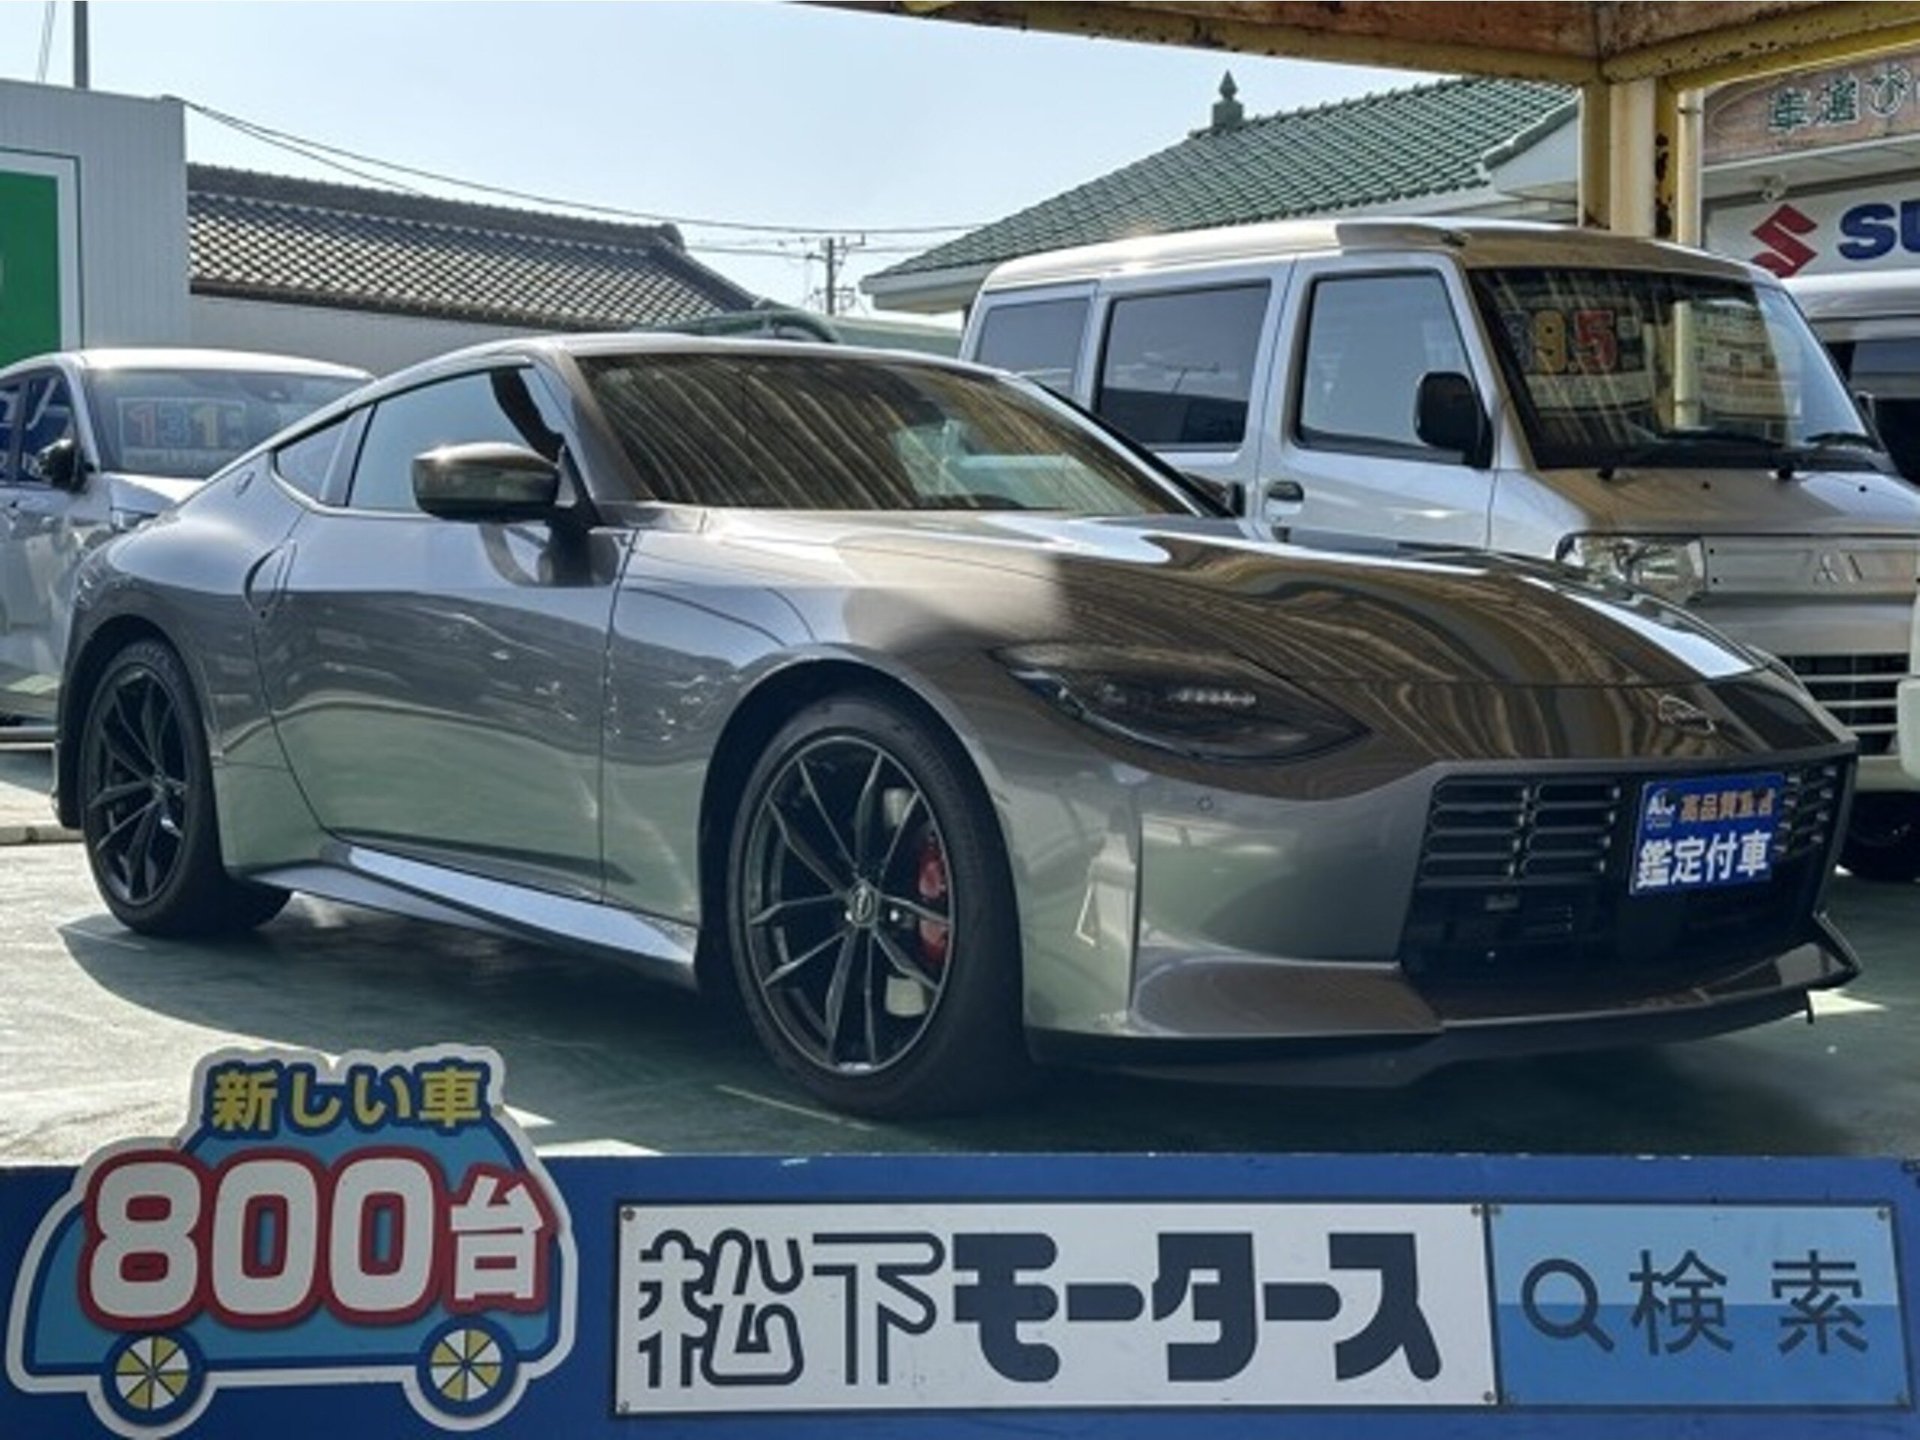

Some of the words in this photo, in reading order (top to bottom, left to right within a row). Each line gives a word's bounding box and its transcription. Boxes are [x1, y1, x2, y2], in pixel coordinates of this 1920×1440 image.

[1768, 62, 1920, 135] 車選び
[1635, 829, 1773, 889] 鑑定付車
[211, 1066, 482, 1132] 新しい車
[89, 1156, 544, 1317] 800台
[638, 1228, 1442, 1388] 松下モータース
[1629, 1249, 1869, 1357] 検索
